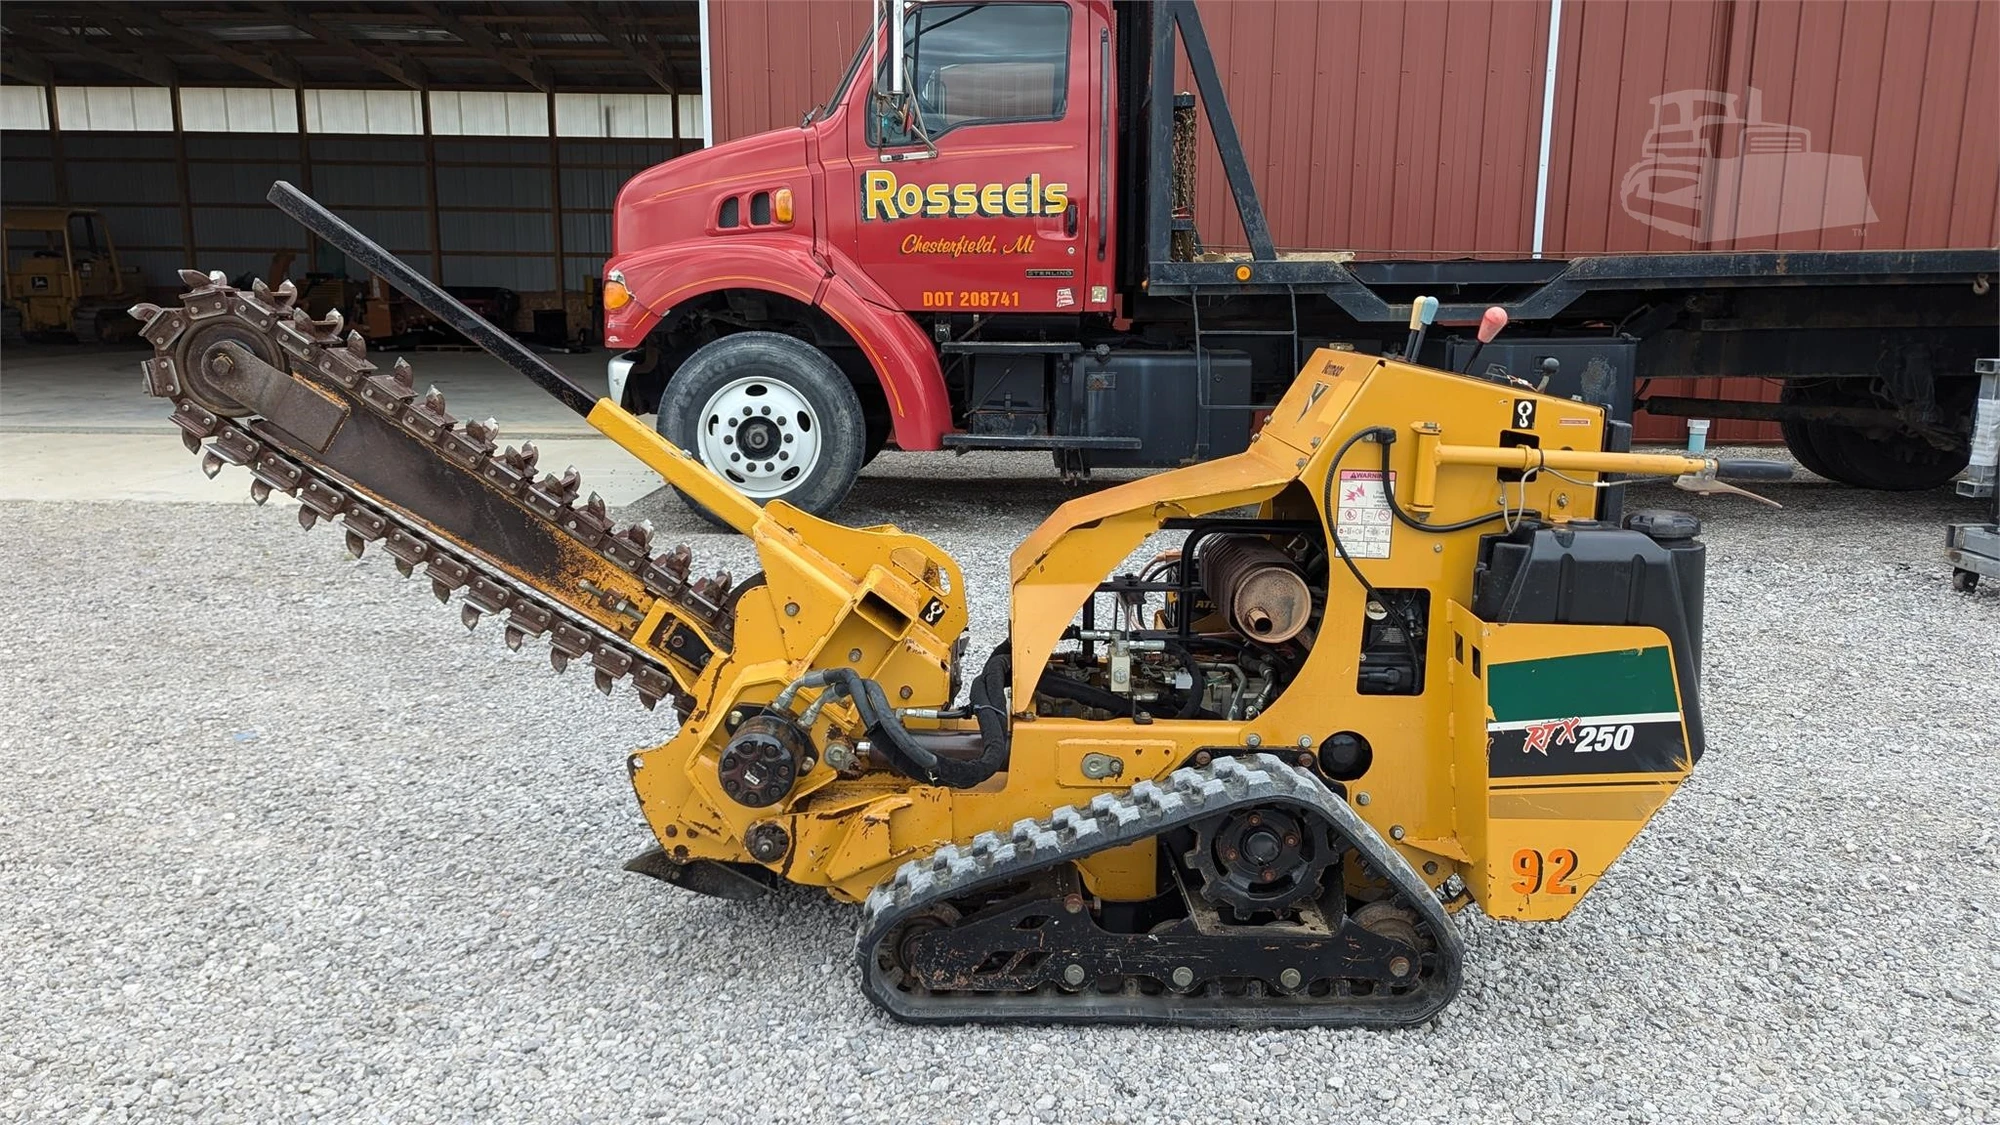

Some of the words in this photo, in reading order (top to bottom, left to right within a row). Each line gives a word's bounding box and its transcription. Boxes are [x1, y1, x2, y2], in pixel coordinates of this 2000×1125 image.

[864, 170, 1069, 220] Rosseels
[1003, 234, 1035, 254] Mi
[924, 291, 955, 307] DOT
[960, 291, 1019, 307] 208741
[1574, 725, 1635, 753] 250
[1512, 848, 1578, 894] 92
